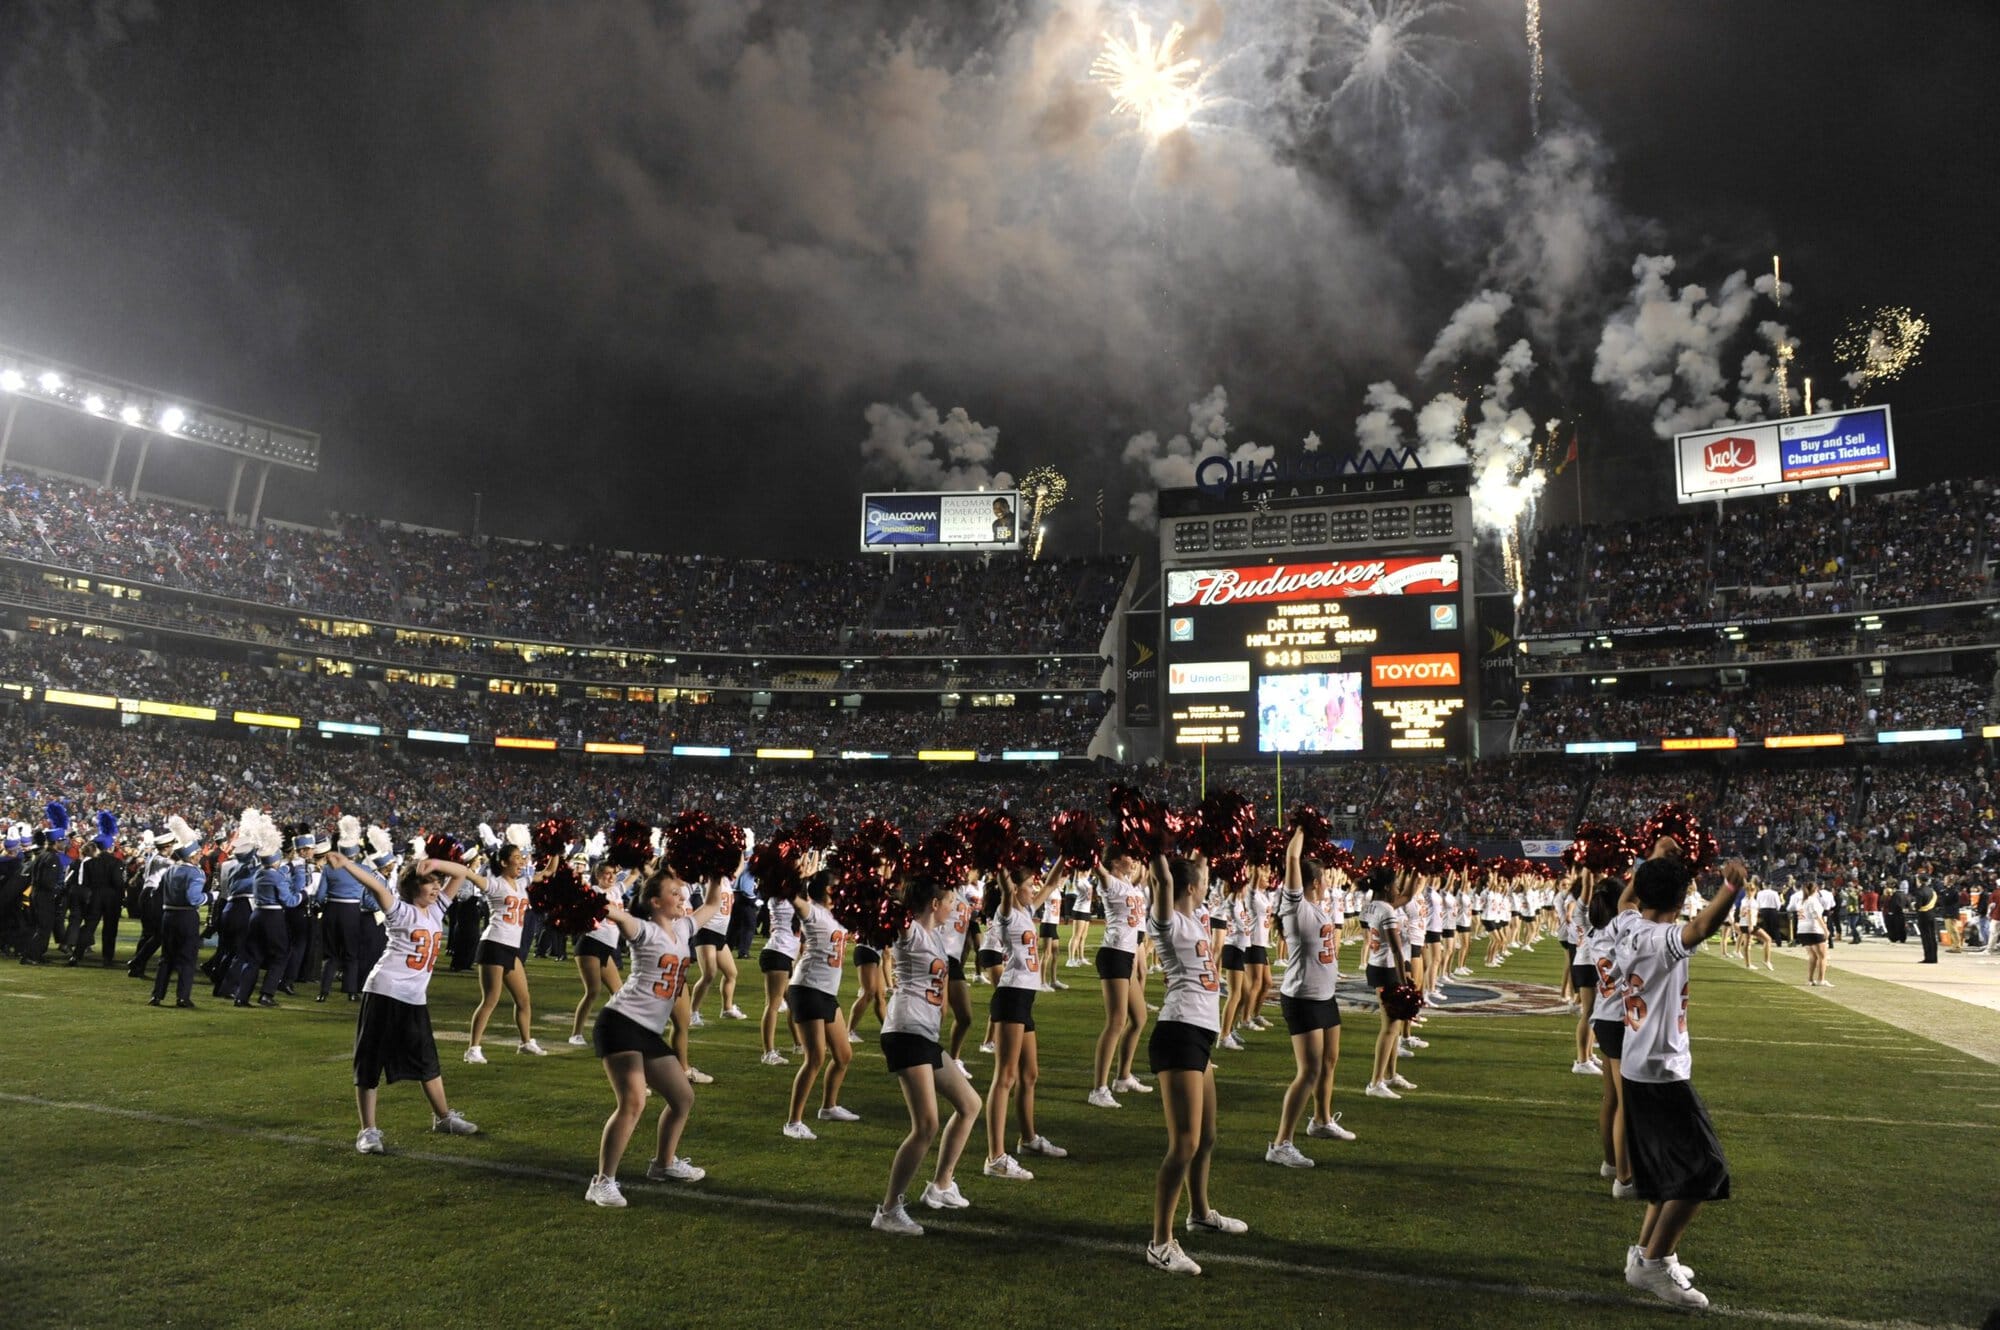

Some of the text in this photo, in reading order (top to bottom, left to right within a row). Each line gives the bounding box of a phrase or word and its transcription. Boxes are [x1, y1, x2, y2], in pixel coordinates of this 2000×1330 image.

[1800, 433, 1866, 451] Buy and Sell
[1706, 440, 1754, 471] Jack
[1788, 443, 1881, 465] Chargers Tickets!
[1242, 478, 1404, 500] STADIUM
[869, 510, 937, 526] QUALCOMM
[881, 525, 926, 533] Innovation
[1192, 561, 1385, 606] Budweiser
[1277, 603, 1340, 616] THANKS TO
[1267, 616, 1350, 631] DR PEPPER
[1246, 629, 1377, 647] HALFTIME SHOW
[1375, 662, 1456, 680] TOYOTA
[1480, 656, 1515, 670] Sprint
[1127, 668, 1156, 681] Sprint
